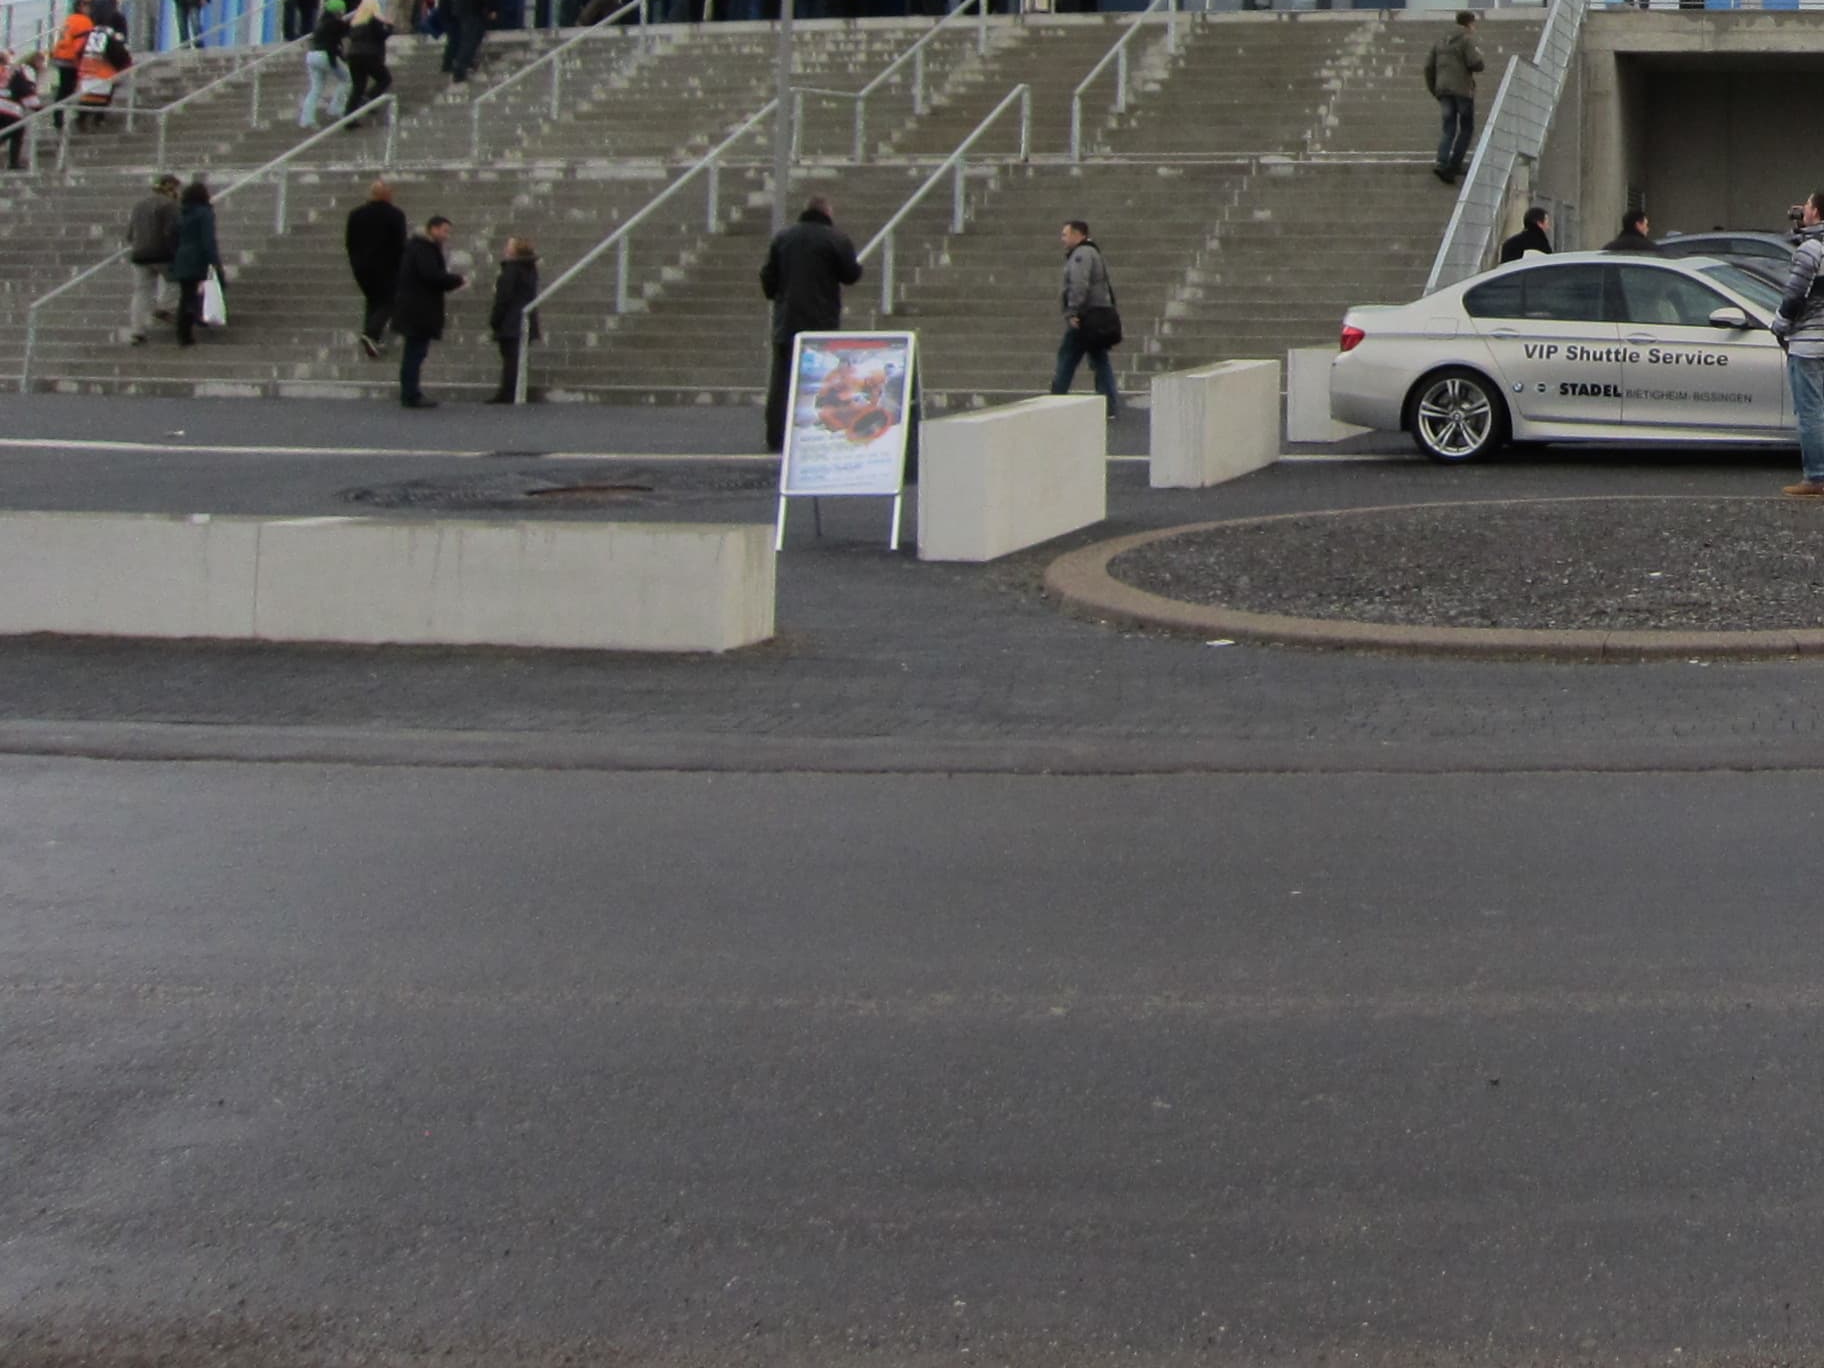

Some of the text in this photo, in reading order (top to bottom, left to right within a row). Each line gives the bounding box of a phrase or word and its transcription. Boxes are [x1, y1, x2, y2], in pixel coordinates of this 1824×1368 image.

[1524, 343, 1729, 367] VIP Shuttle Service
[1559, 382, 1622, 398] STADEL
